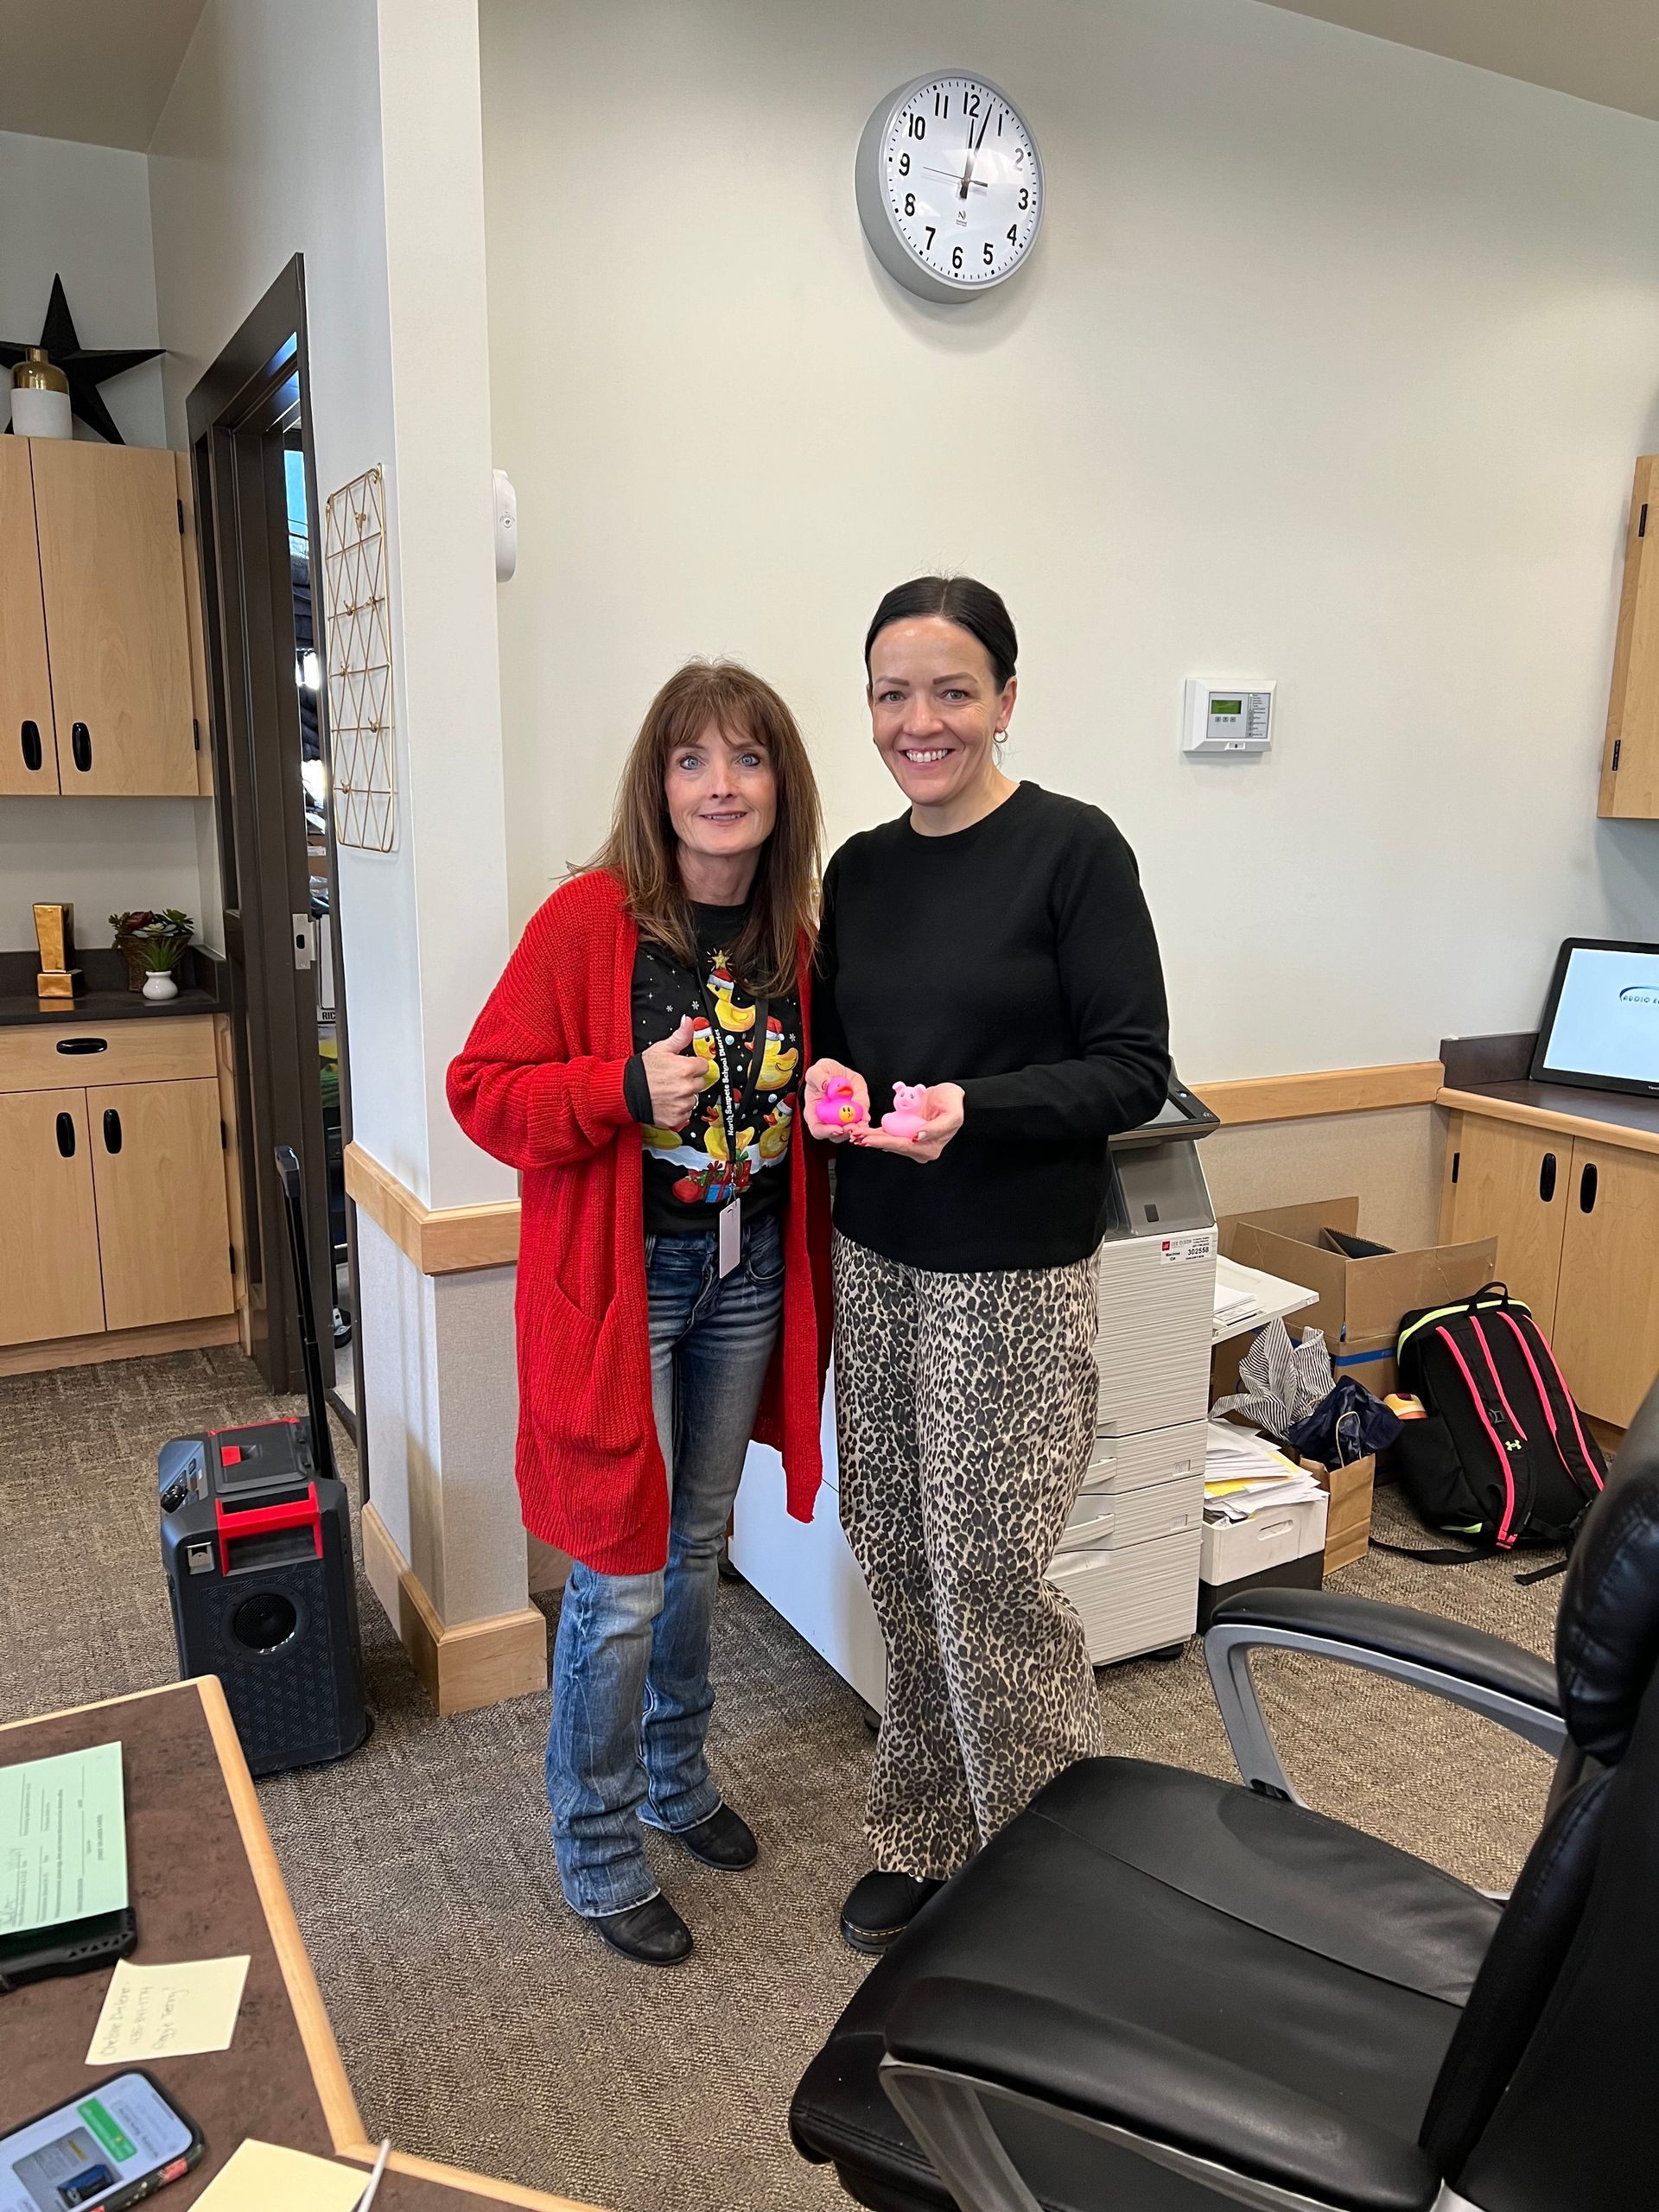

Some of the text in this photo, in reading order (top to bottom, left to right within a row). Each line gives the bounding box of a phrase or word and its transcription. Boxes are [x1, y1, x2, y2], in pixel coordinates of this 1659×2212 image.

[934, 92, 949, 119] 11
[963, 92, 981, 118] 12
[908, 113, 926, 141] 10
[997, 113, 1003, 137] 1
[898, 153, 911, 176] 9
[1014, 148, 1025, 172] 2
[904, 193, 916, 217] 8
[1018, 188, 1029, 210] 3
[925, 226, 937, 251] 7
[1007, 224, 1018, 246] 4
[952, 246, 963, 269] 6
[982, 242, 994, 265] 5
[1623, 995, 1650, 1003] AUDIO
[715, 1028, 734, 1136] North Sanpete School District
[1187, 1246, 1210, 1255] 302558
